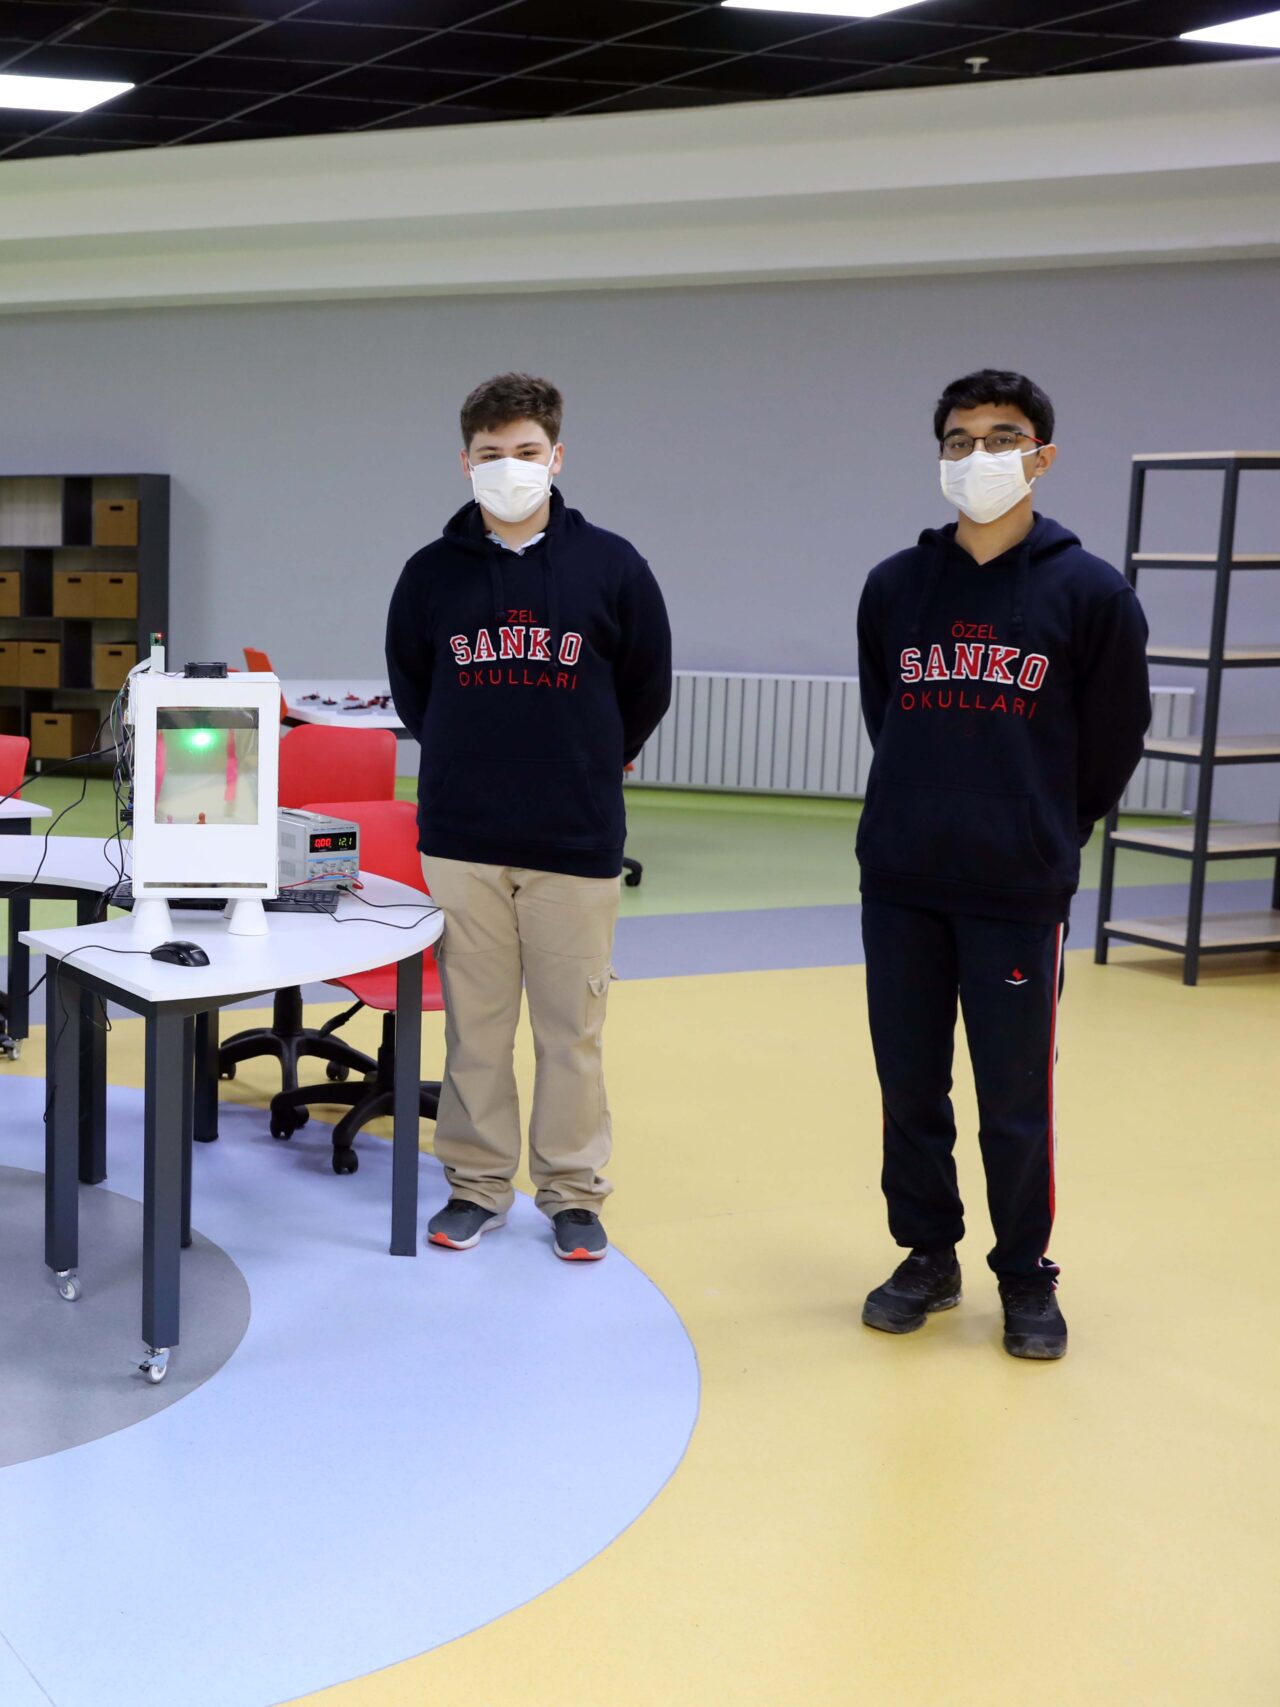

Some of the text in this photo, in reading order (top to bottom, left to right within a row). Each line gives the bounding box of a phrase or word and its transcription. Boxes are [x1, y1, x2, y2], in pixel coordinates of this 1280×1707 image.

[505, 609, 538, 624] ZEL
[951, 620, 999, 640] ÖZEL
[449, 626, 583, 666] SANKO
[458, 668, 578, 691] OKULLARI
[900, 643, 1050, 692] SANKO
[900, 690, 1038, 720] OKULLARI
